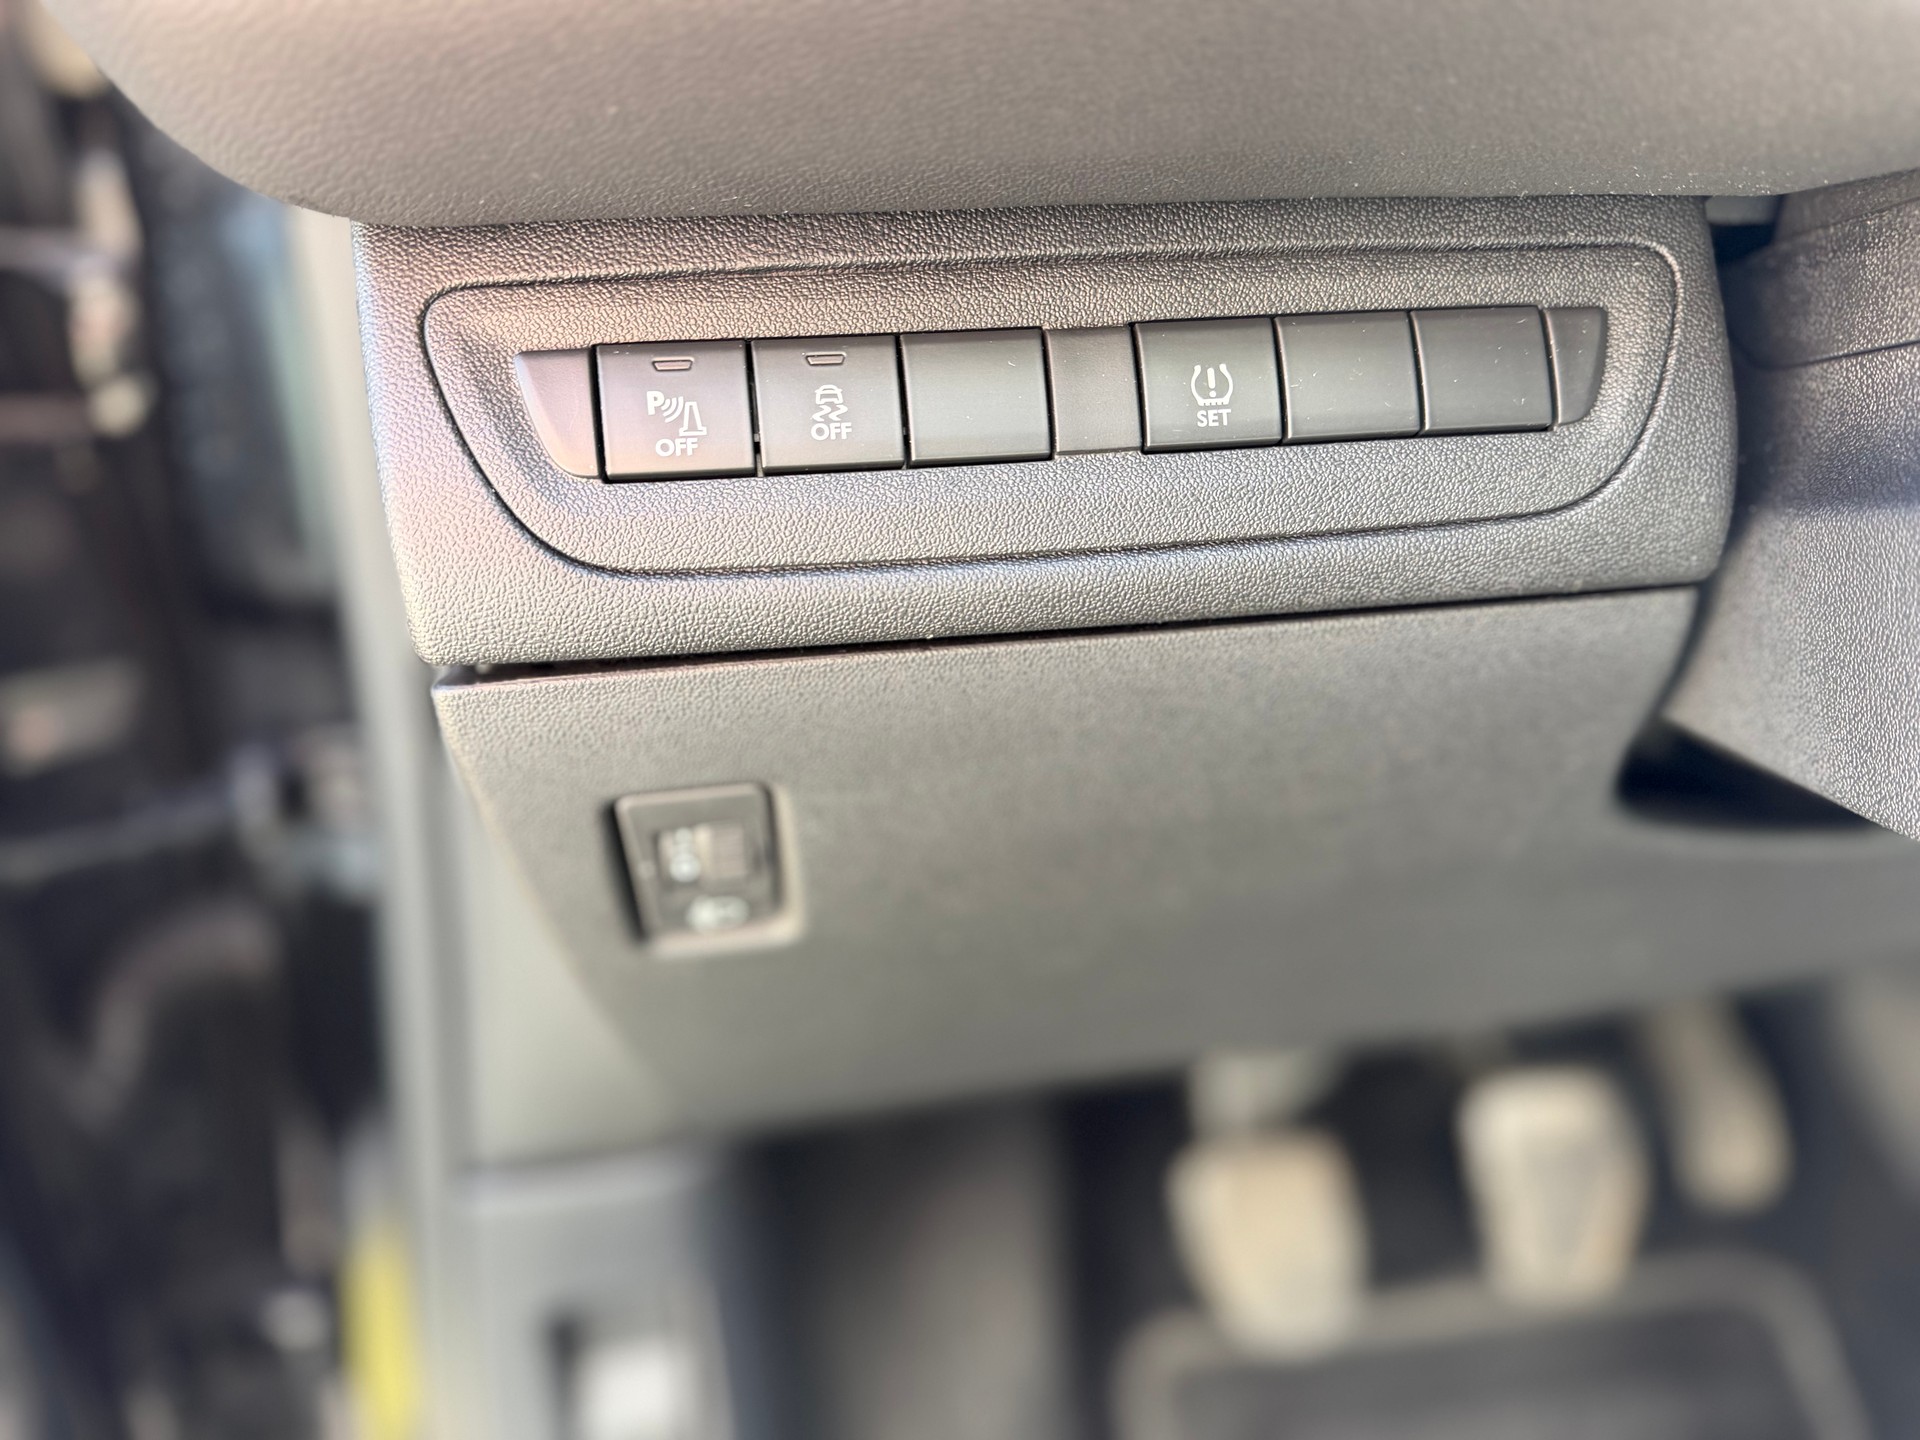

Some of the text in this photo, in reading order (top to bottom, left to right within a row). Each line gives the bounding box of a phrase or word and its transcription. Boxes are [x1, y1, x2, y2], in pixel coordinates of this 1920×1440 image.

[646, 390, 664, 415] P
[1196, 408, 1231, 427] SET
[810, 421, 852, 441] OFF
[655, 437, 698, 457] OFF
